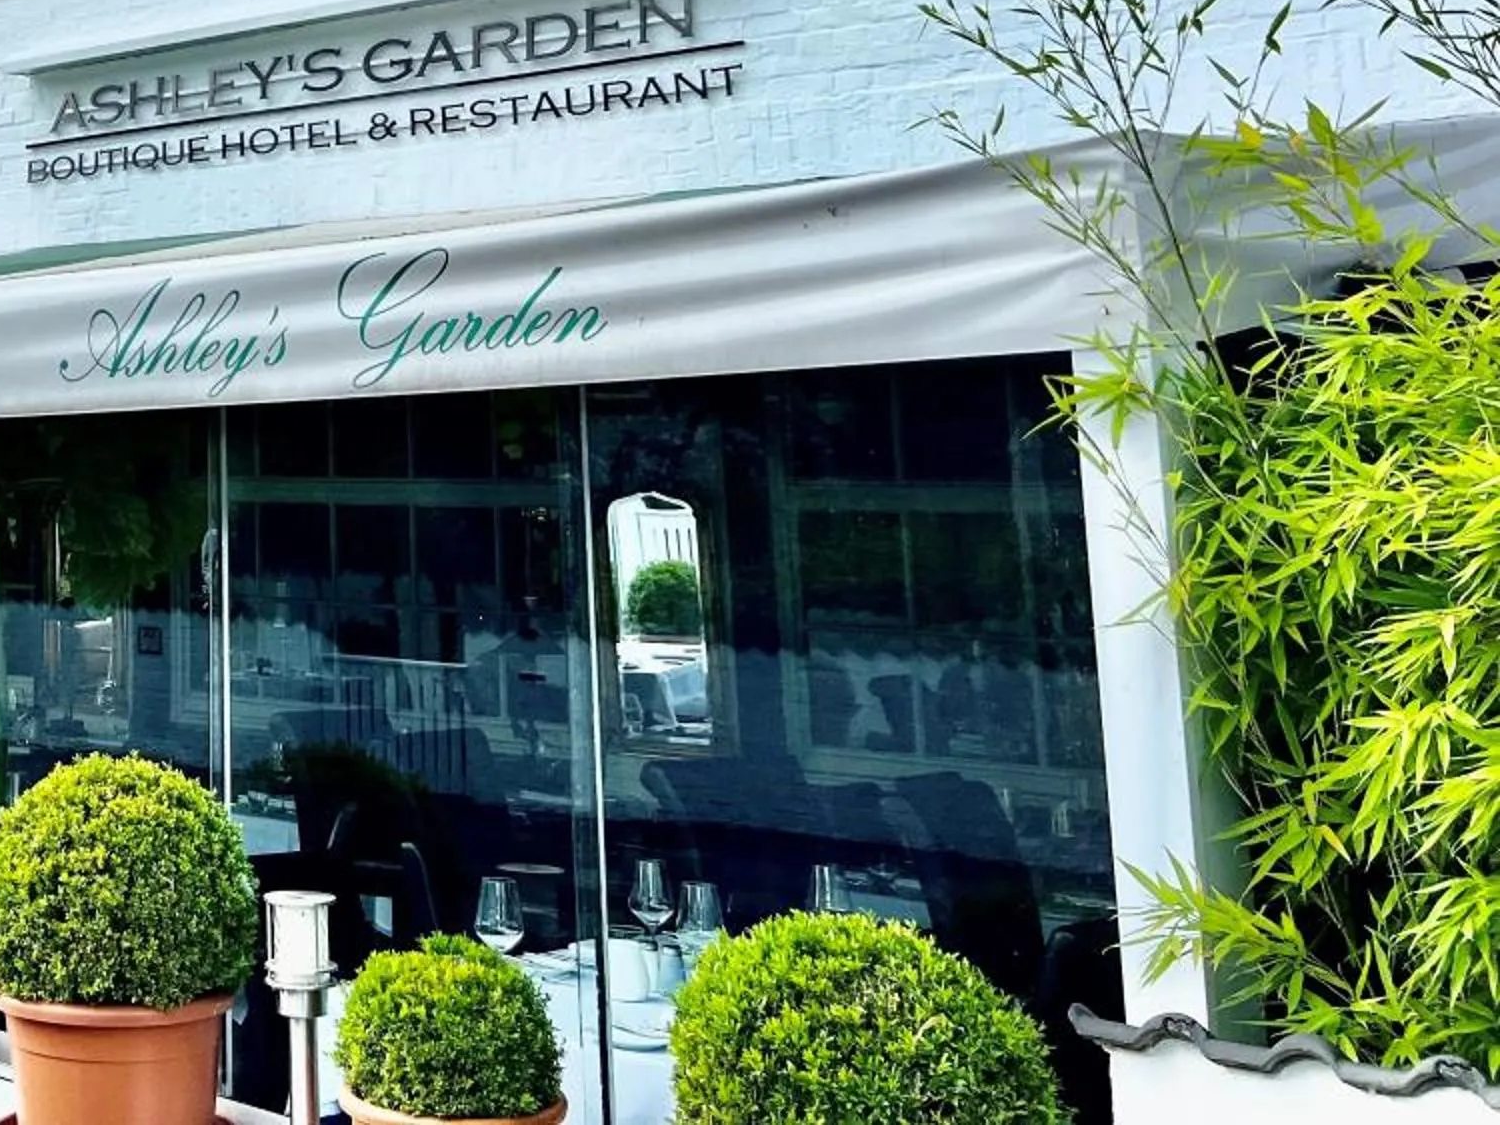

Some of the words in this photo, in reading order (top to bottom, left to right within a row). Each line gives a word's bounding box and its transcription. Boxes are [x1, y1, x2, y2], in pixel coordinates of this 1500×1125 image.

[26, 135, 210, 184] BOUTIQUE
[221, 118, 358, 159] HOTEL
[367, 112, 398, 142] &
[409, 62, 743, 137] RESTAURANT
[50, 48, 345, 133] ASHLEY'S
[59, 277, 289, 398] Ashley's
[337, 247, 608, 389] Garden
